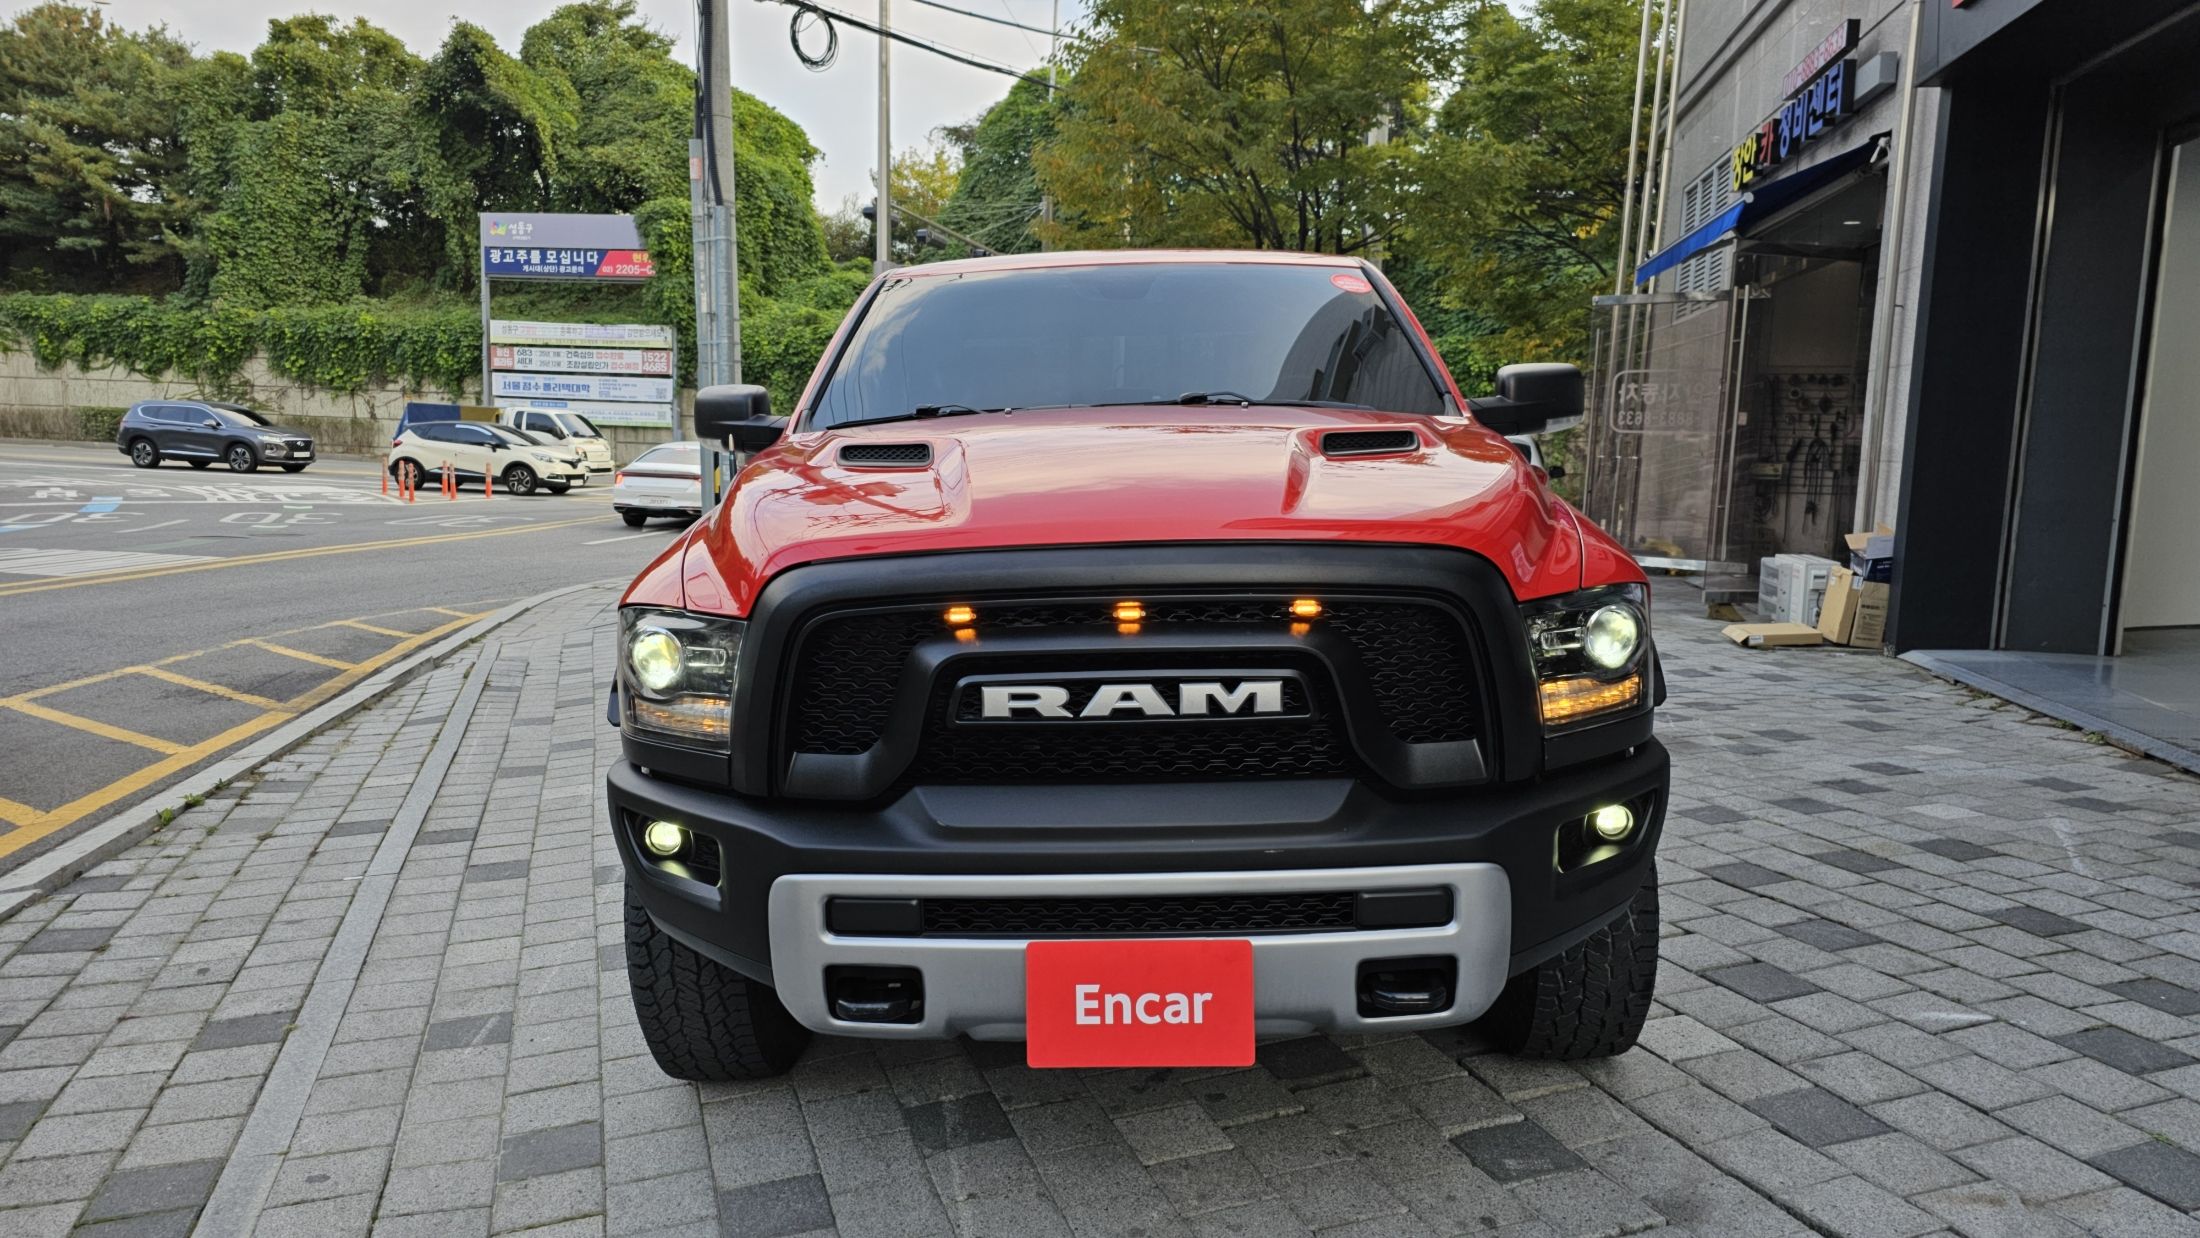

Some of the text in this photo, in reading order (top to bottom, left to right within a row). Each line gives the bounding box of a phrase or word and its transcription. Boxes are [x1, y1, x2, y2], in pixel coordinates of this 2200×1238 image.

[1732, 59, 1844, 191] 장안 카 정비센터
[508, 221, 533, 235] 성동구
[489, 249, 599, 265] 광고주를 모십니다
[642, 352, 667, 363] 1522
[981, 681, 1283, 718] RAM
[1075, 984, 1213, 1025] Encar
